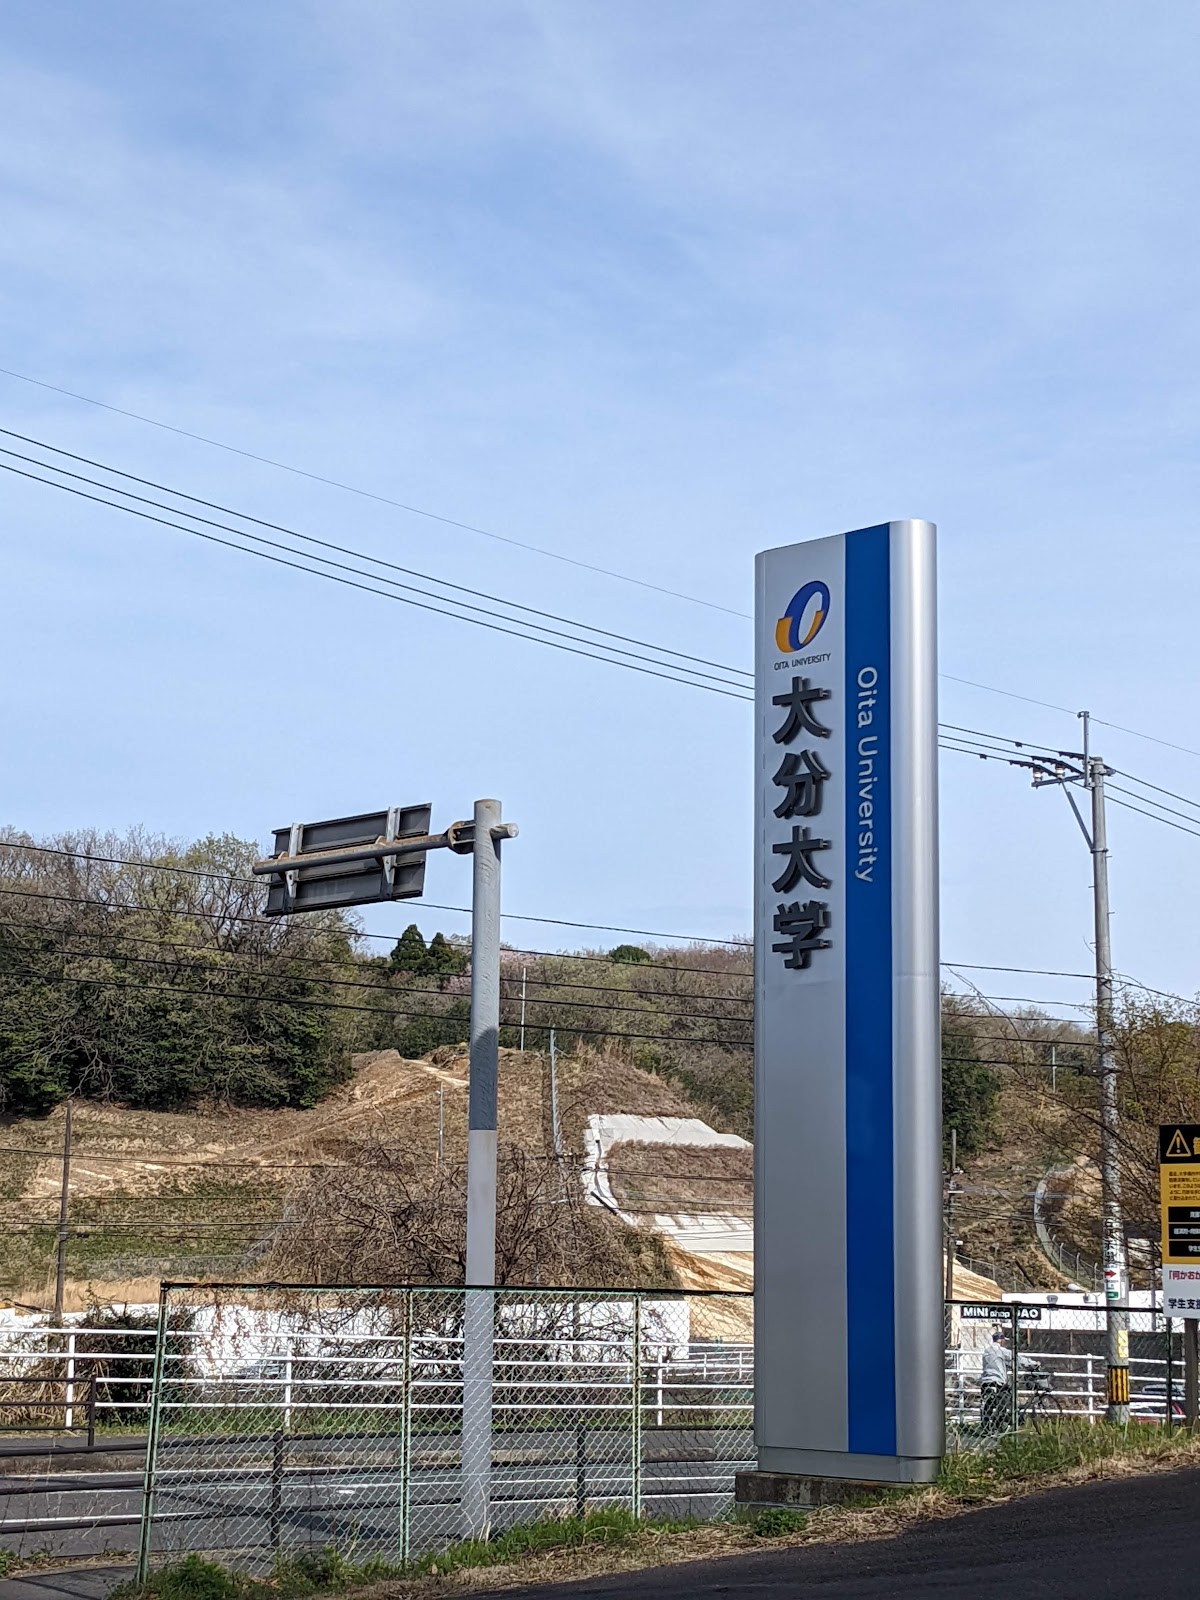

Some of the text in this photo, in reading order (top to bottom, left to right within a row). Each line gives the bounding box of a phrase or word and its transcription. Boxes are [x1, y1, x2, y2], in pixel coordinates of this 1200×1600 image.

[774, 653, 831, 671] OITA UNIVERSITY
[772, 676, 830, 969] 大分大学
[855, 666, 878, 883] Oita University
[963, 1307, 989, 1317] MINI
